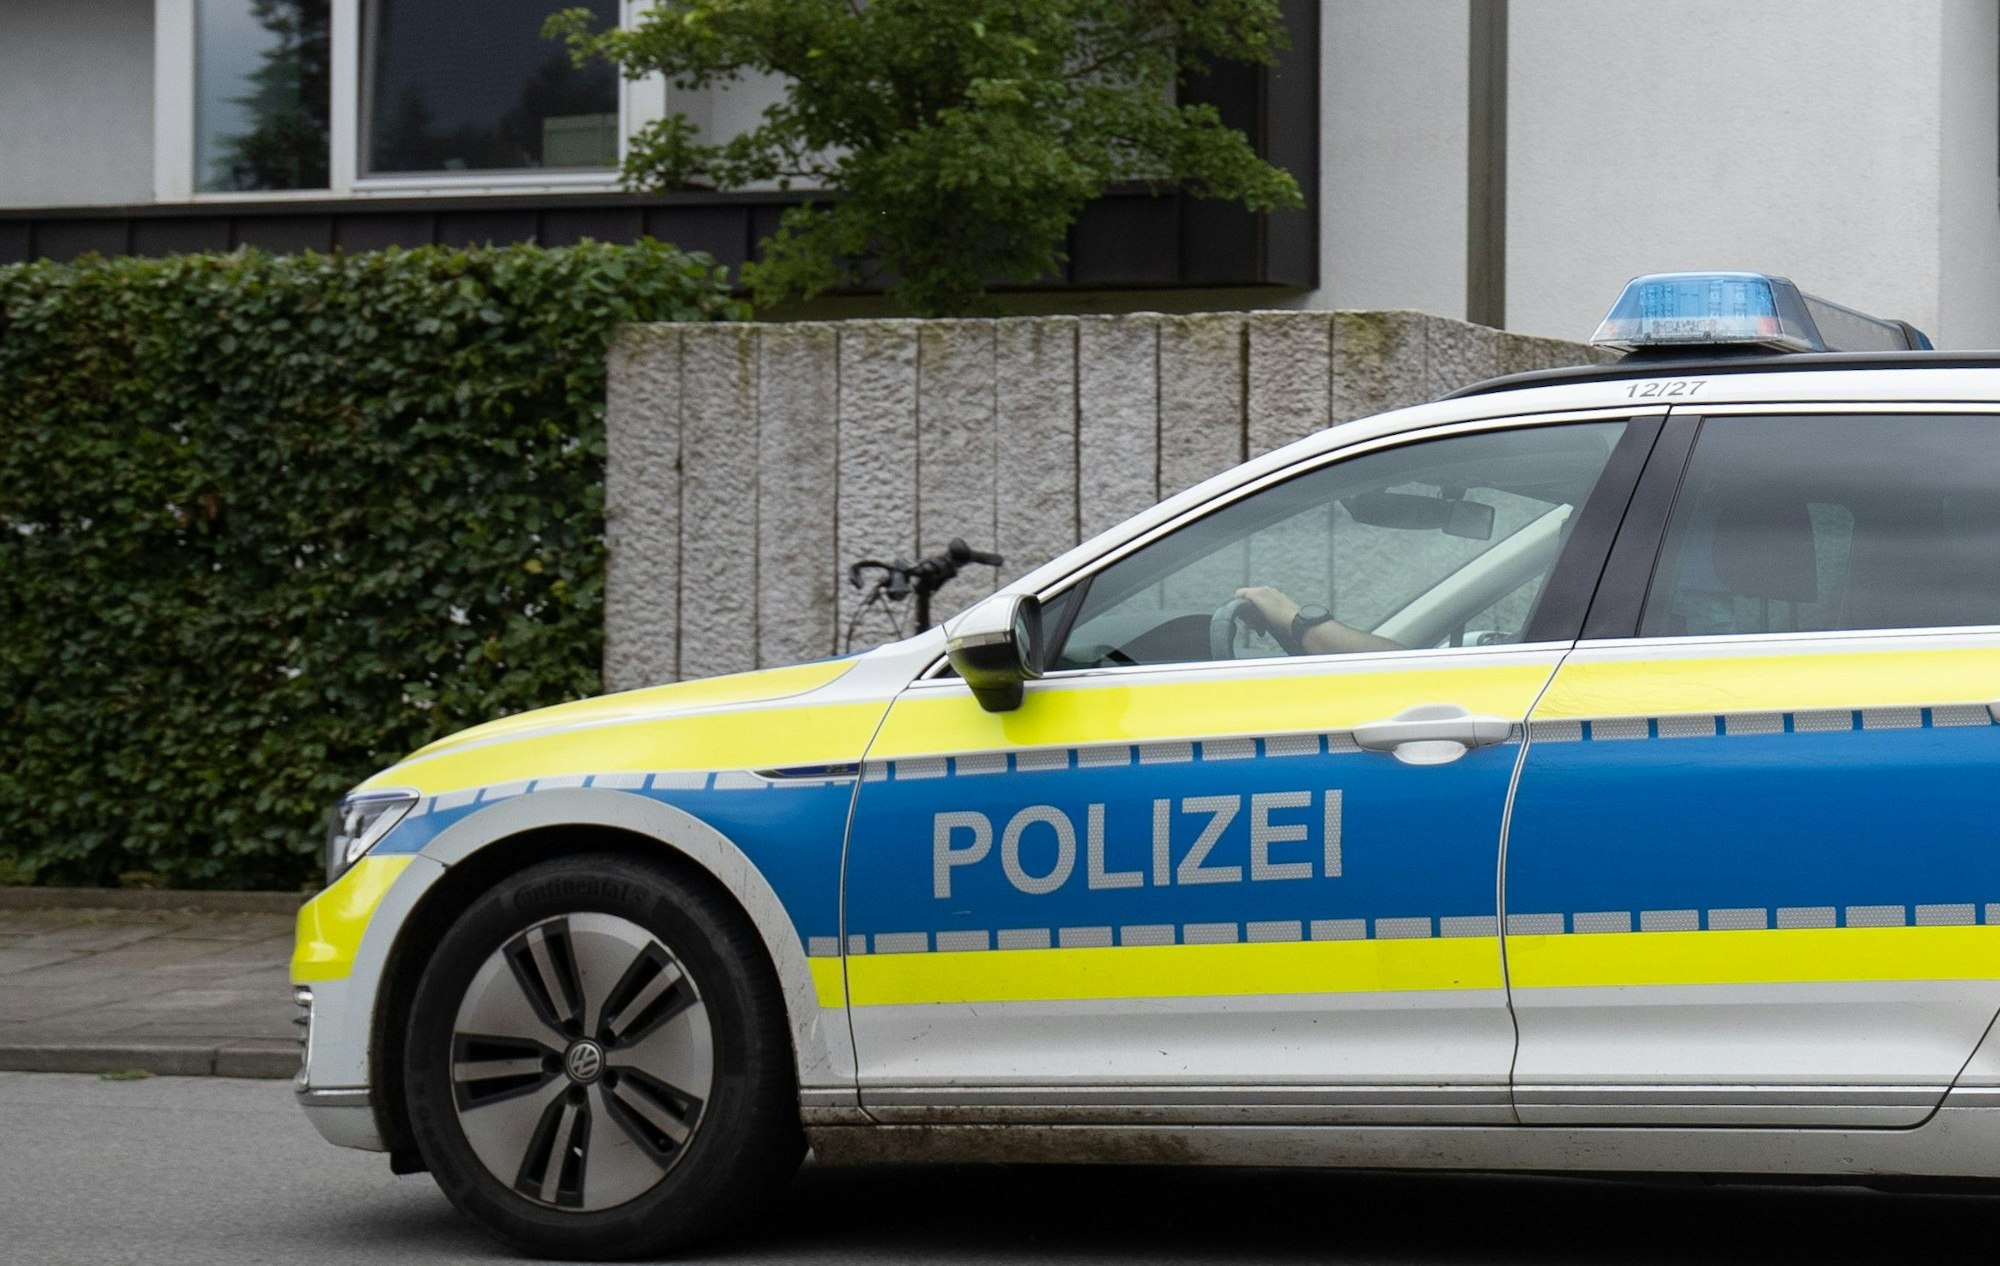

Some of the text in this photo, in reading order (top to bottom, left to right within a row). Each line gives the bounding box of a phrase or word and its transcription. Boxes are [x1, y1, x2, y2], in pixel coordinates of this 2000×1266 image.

[1626, 380, 1707, 398] 12/27
[933, 788, 1343, 900] POLIZEI
[513, 876, 629, 907] Continental
